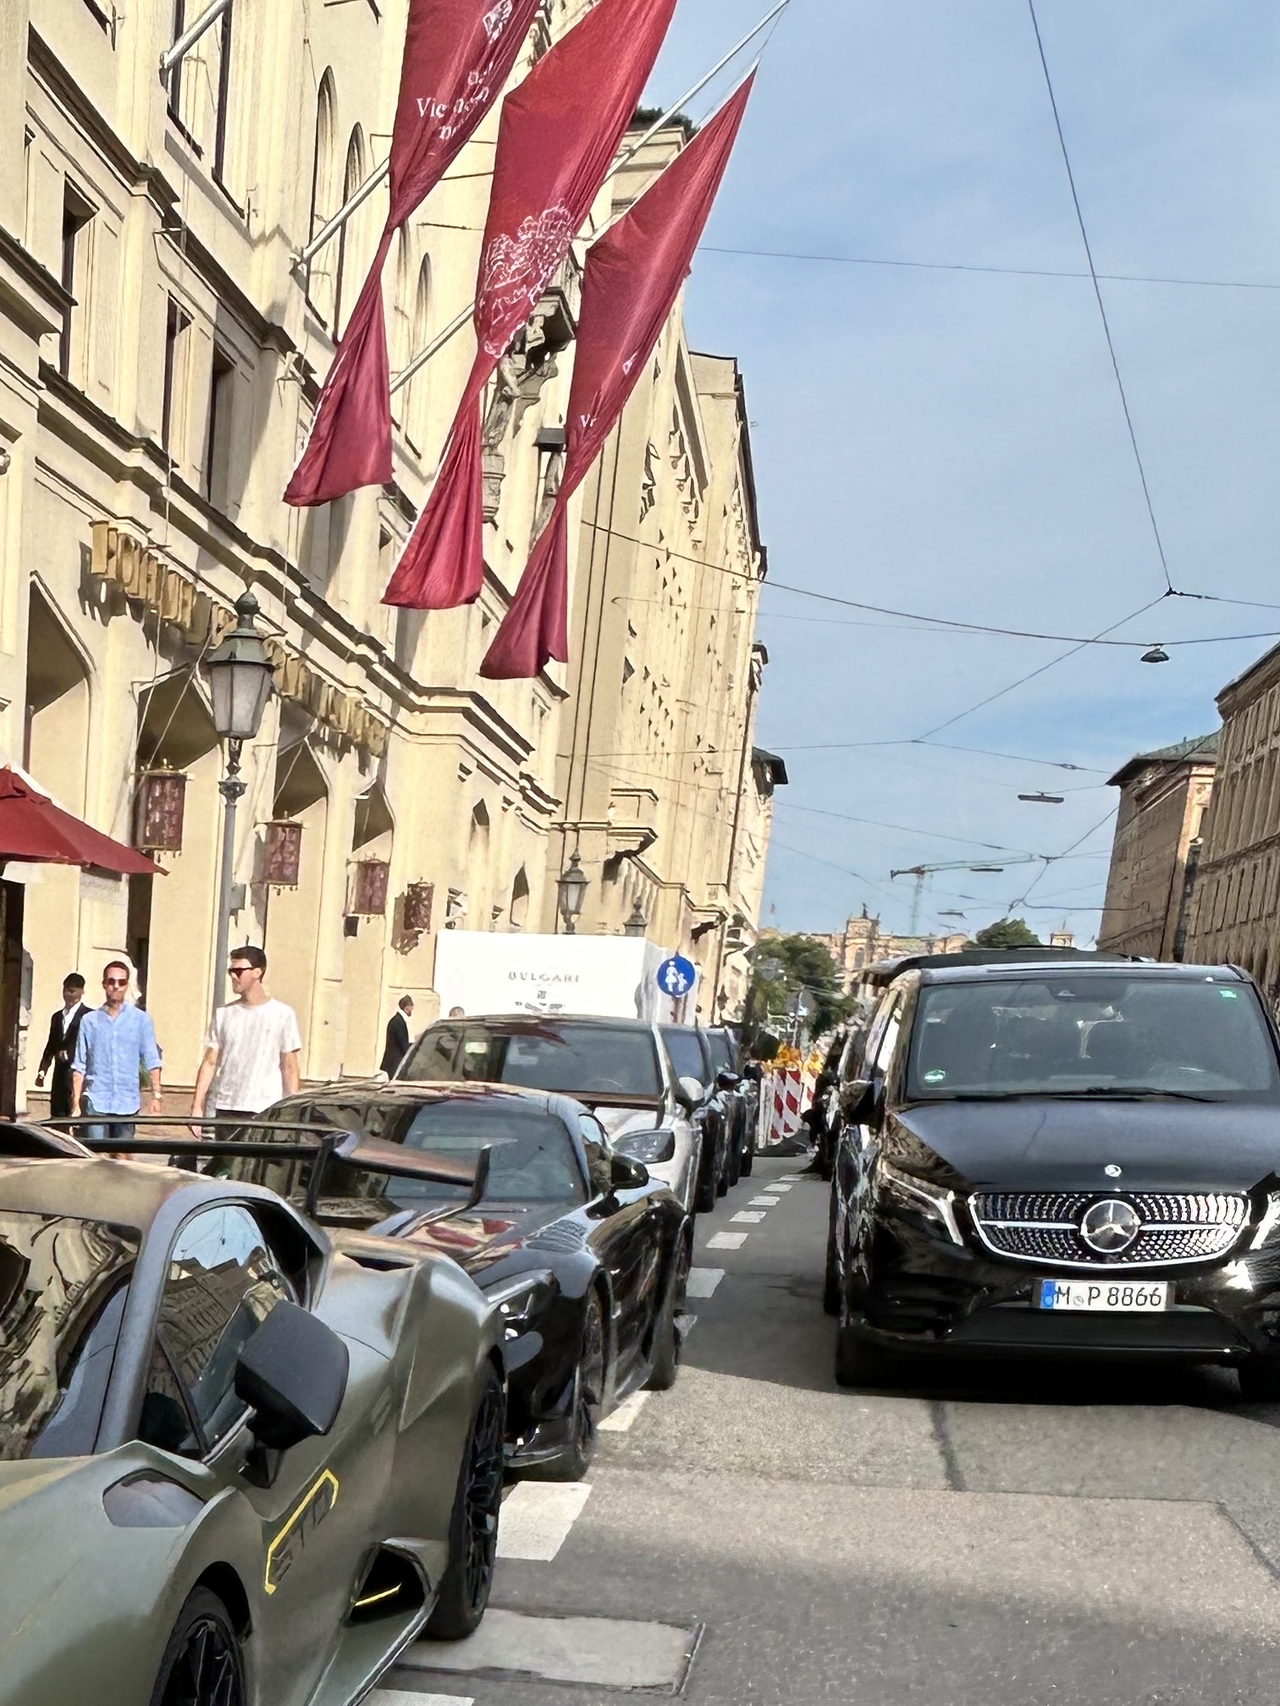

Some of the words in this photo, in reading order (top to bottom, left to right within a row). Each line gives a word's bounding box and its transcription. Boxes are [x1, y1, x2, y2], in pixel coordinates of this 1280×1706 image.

[1055, 1286, 1070, 1305] M
[1088, 1286, 1101, 1306] P
[1107, 1286, 1162, 1306] 8866
